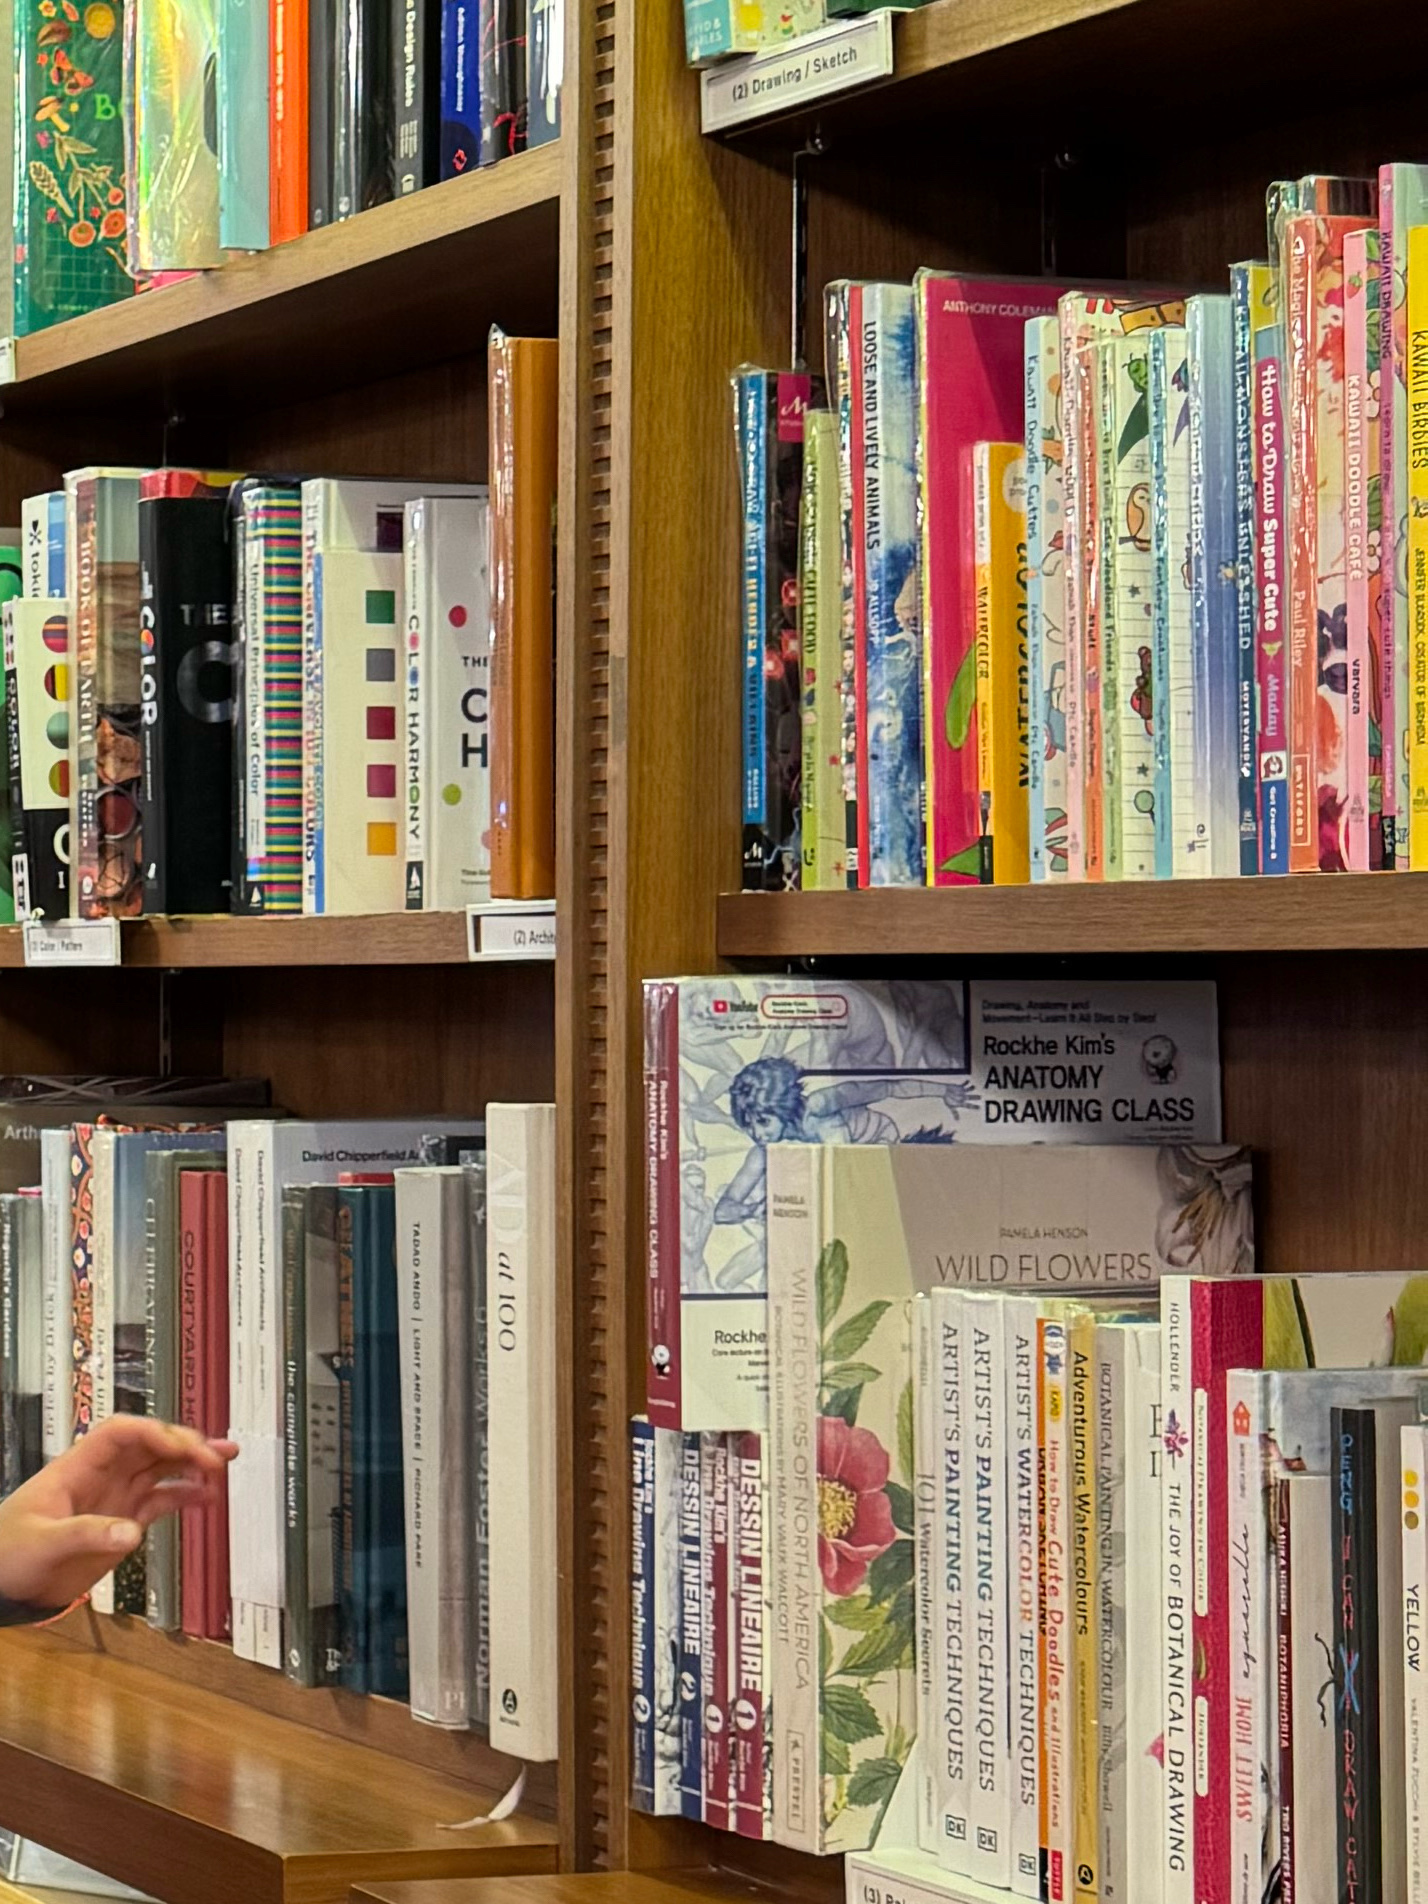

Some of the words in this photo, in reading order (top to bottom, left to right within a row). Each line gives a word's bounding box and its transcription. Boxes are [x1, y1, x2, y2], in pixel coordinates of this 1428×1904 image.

[405, 11, 416, 63] Design
[732, 81, 749, 102] (2)
[752, 67, 802, 95] Drawing
[813, 46, 857, 71] Sketch
[864, 320, 878, 373] LOOSE
[1412, 330, 1428, 394] KAWAII
[864, 377, 878, 413] AND
[864, 416, 880, 473] LIVELY
[1412, 401, 1428, 471] BIRDIES
[865, 476, 881, 551] ANIMALS
[409, 712, 422, 841] HARMONY
[983, 1036, 1058, 1056] Rockhe
[1065, 1032, 1115, 1056] Kim's
[984, 1065, 1104, 1089] ANATOMY
[985, 1099, 1102, 1124] DRAWING
[1112, 1097, 1195, 1122] CLASS
[302, 1150, 334, 1163] David
[1000, 1226, 1042, 1239] PAMELA
[1044, 1226, 1089, 1240] HENSON
[791, 1269, 807, 1325] WILD
[936, 1253, 1010, 1283] WILD
[1019, 1253, 1153, 1282] FLOWERS
[184, 1230, 196, 1392] COURTYARD
[714, 1330, 767, 1345] Rockhe
[287, 1360, 297, 1388] the
[1169, 1302, 1180, 1393] HOLLENDER
[792, 1334, 809, 1449] FLOWERS
[943, 1323, 961, 1442] ARTIST'S
[1016, 1334, 1032, 1442] ARTIST'S
[287, 1390, 298, 1471] complete
[1073, 1350, 1089, 1487] Adventurous
[794, 1456, 809, 1486] OF
[1168, 1484, 1181, 1518] THE
[287, 1477, 299, 1528] works
[944, 1446, 962, 1593] PAINTING
[794, 1497, 810, 1579] NORTH
[1016, 1447, 1033, 1622] WATERCOLOR
[1168, 1523, 1181, 1558] JOY
[1073, 1493, 1090, 1637] Watercolours
[1168, 1563, 1182, 1590] OF
[795, 1586, 811, 1690] AMERICA
[1406, 1583, 1422, 1671] YELLOW
[945, 1599, 964, 1782] TECHNIQUES
[1167, 1596, 1184, 1738] BOTANICAL
[1019, 1630, 1035, 1807] TECHNIQUES
[947, 1818, 965, 1838] DK
[1168, 1748, 1185, 1873] DRAWING
[1020, 1855, 1035, 1873] DK
